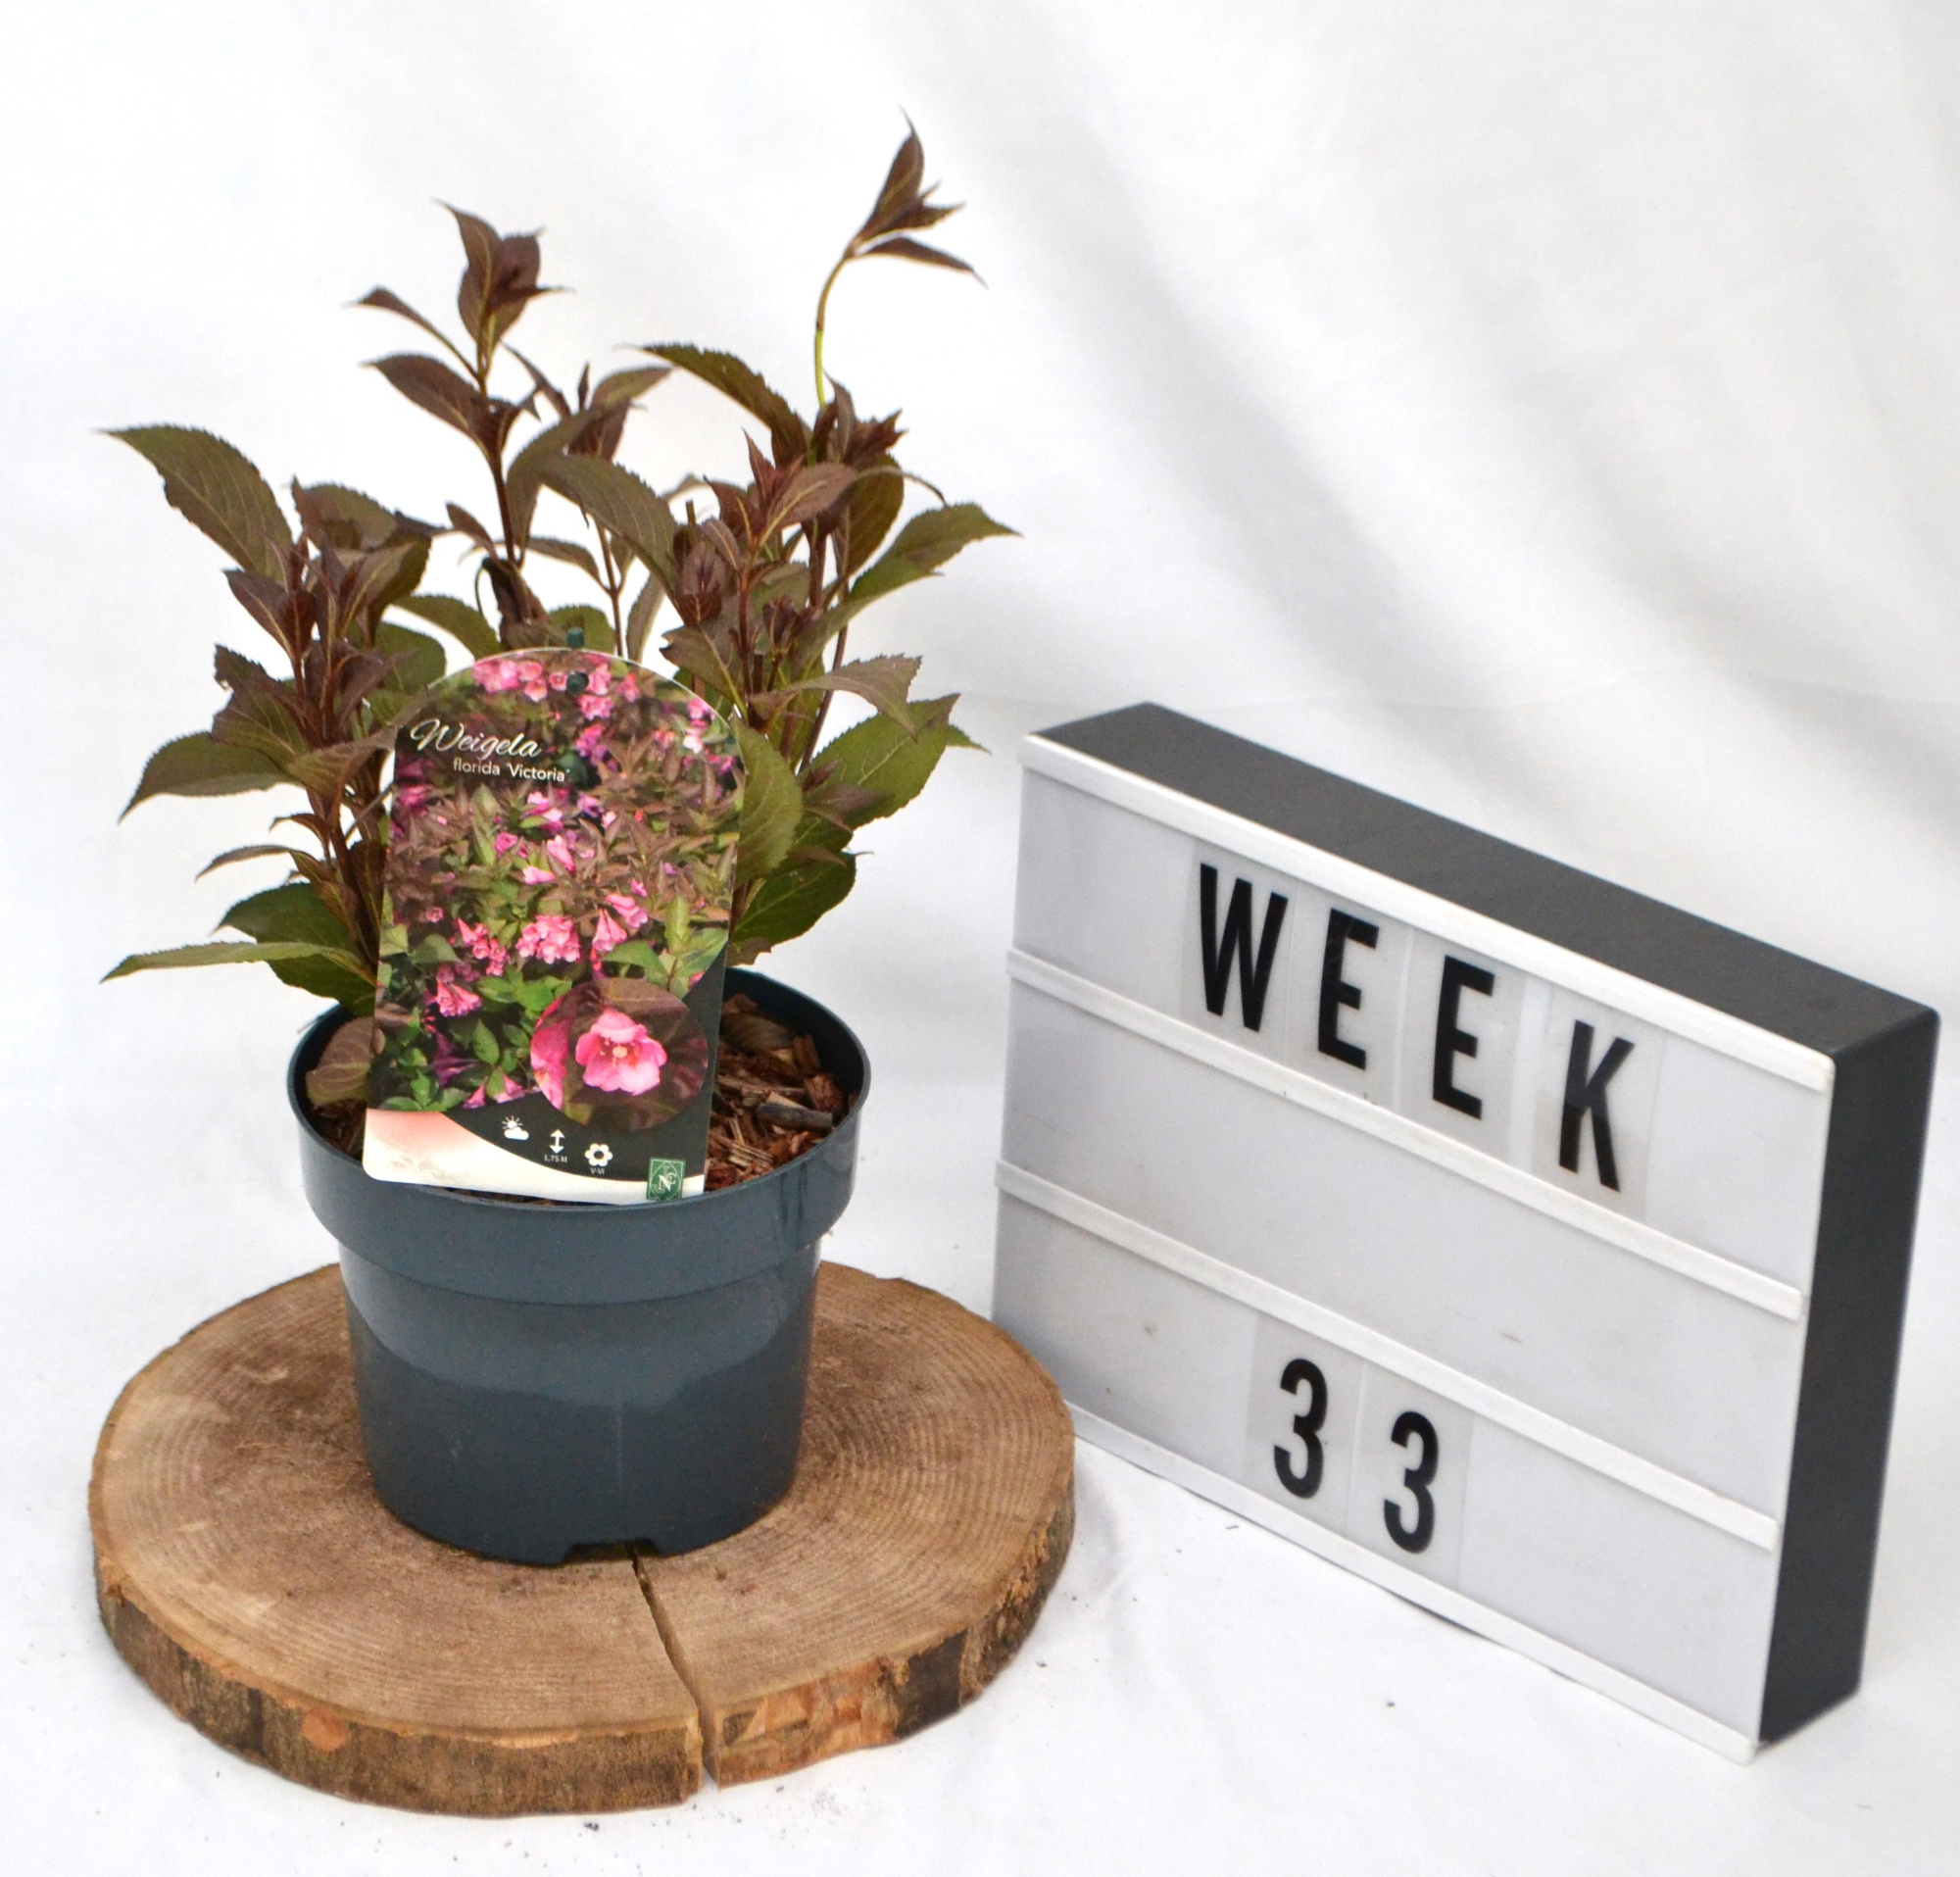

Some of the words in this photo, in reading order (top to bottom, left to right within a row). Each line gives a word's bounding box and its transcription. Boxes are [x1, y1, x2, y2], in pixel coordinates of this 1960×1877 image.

[410, 717, 543, 761] Weigela
[453, 758, 501, 776] florida
[1200, 863, 1636, 1193] WEEK
[1273, 1358, 1439, 1555] 33
